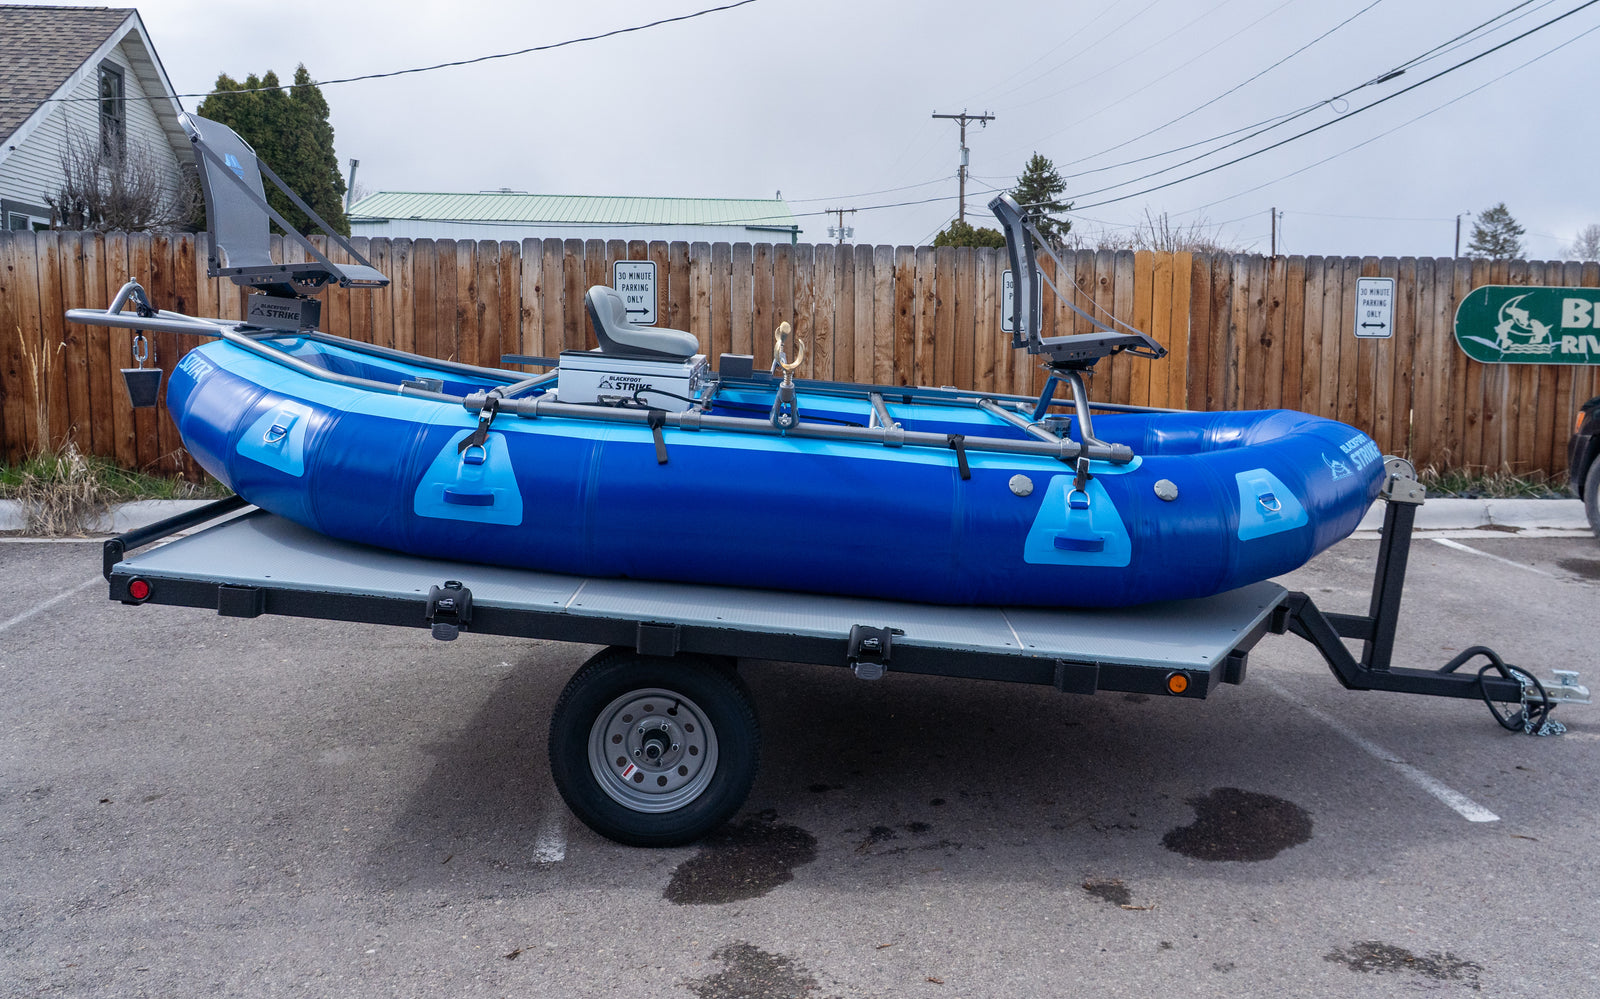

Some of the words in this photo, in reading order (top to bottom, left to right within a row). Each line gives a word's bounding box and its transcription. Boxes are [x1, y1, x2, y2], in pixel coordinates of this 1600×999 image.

[618, 272, 627, 281] 30
[629, 272, 652, 281] MINUTE
[622, 284, 649, 292] PARKING
[1360, 288, 1368, 296] 30
[627, 296, 644, 304] ONLY
[1363, 299, 1387, 307] PARKING
[266, 310, 300, 321] STRIKE
[179, 353, 214, 383] SOTAR
[616, 382, 653, 391] STRIKE
[1350, 440, 1380, 471] STRIKE
